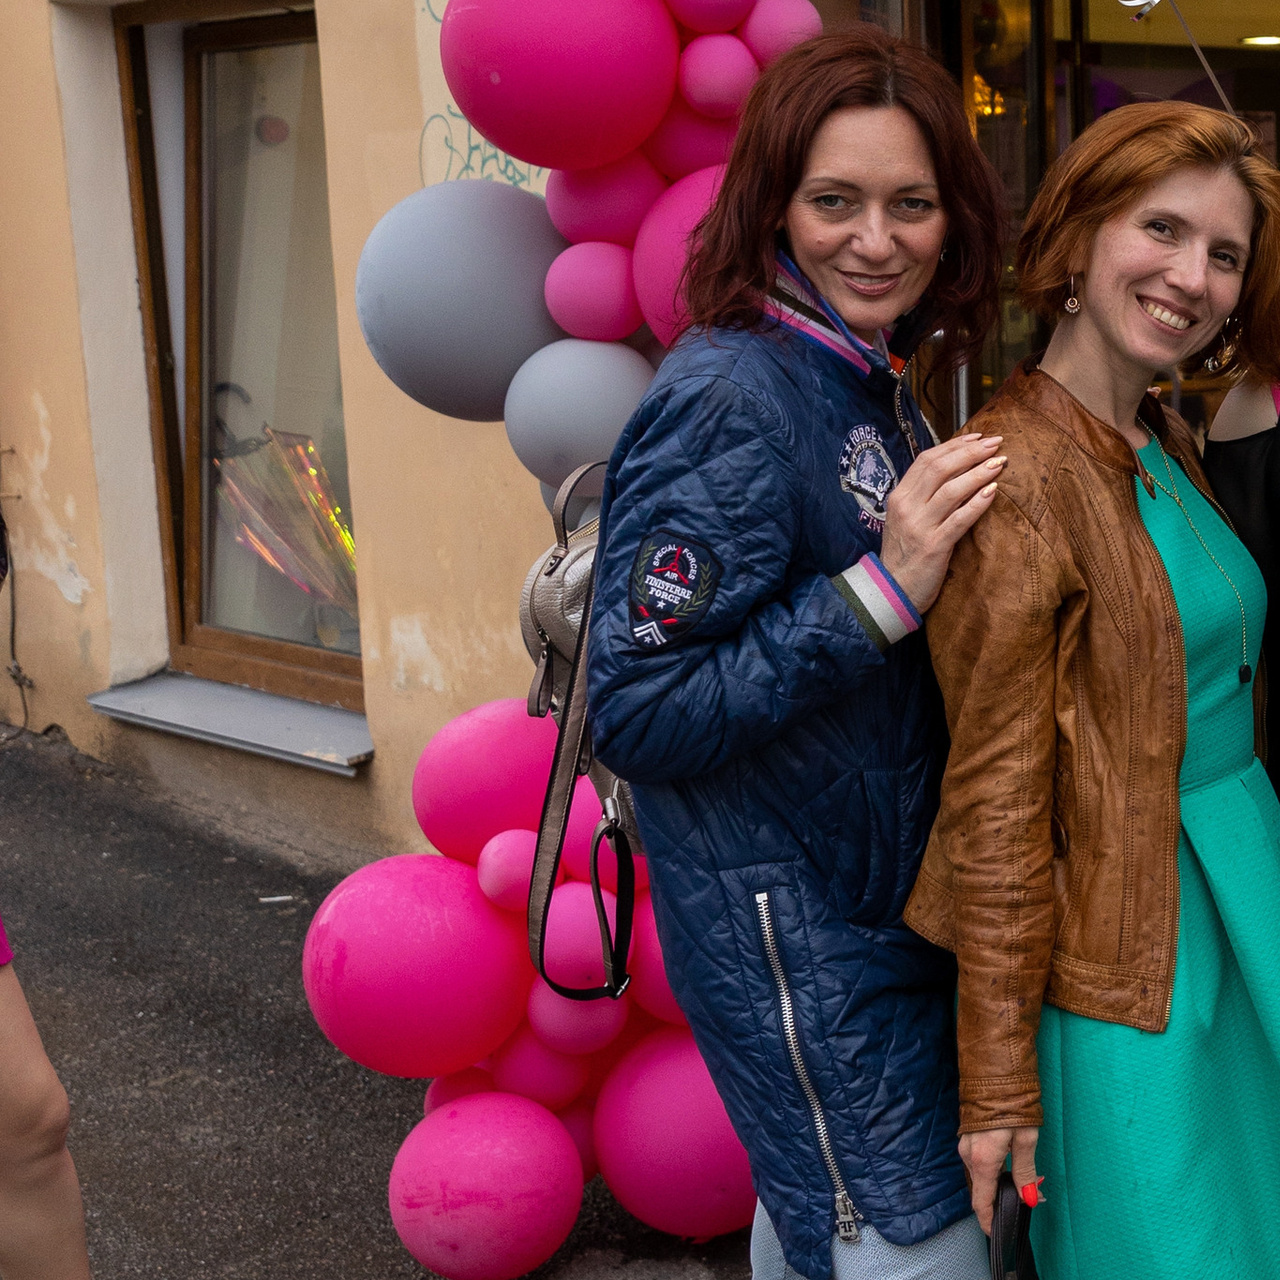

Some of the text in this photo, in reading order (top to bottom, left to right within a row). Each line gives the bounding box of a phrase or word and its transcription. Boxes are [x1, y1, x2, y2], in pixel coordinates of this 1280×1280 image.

[849, 425, 877, 446] FORCE
[653, 544, 698, 581] SPECIAL FORCES
[664, 570, 679, 581] AIR
[648, 586, 681, 605] FORCE
